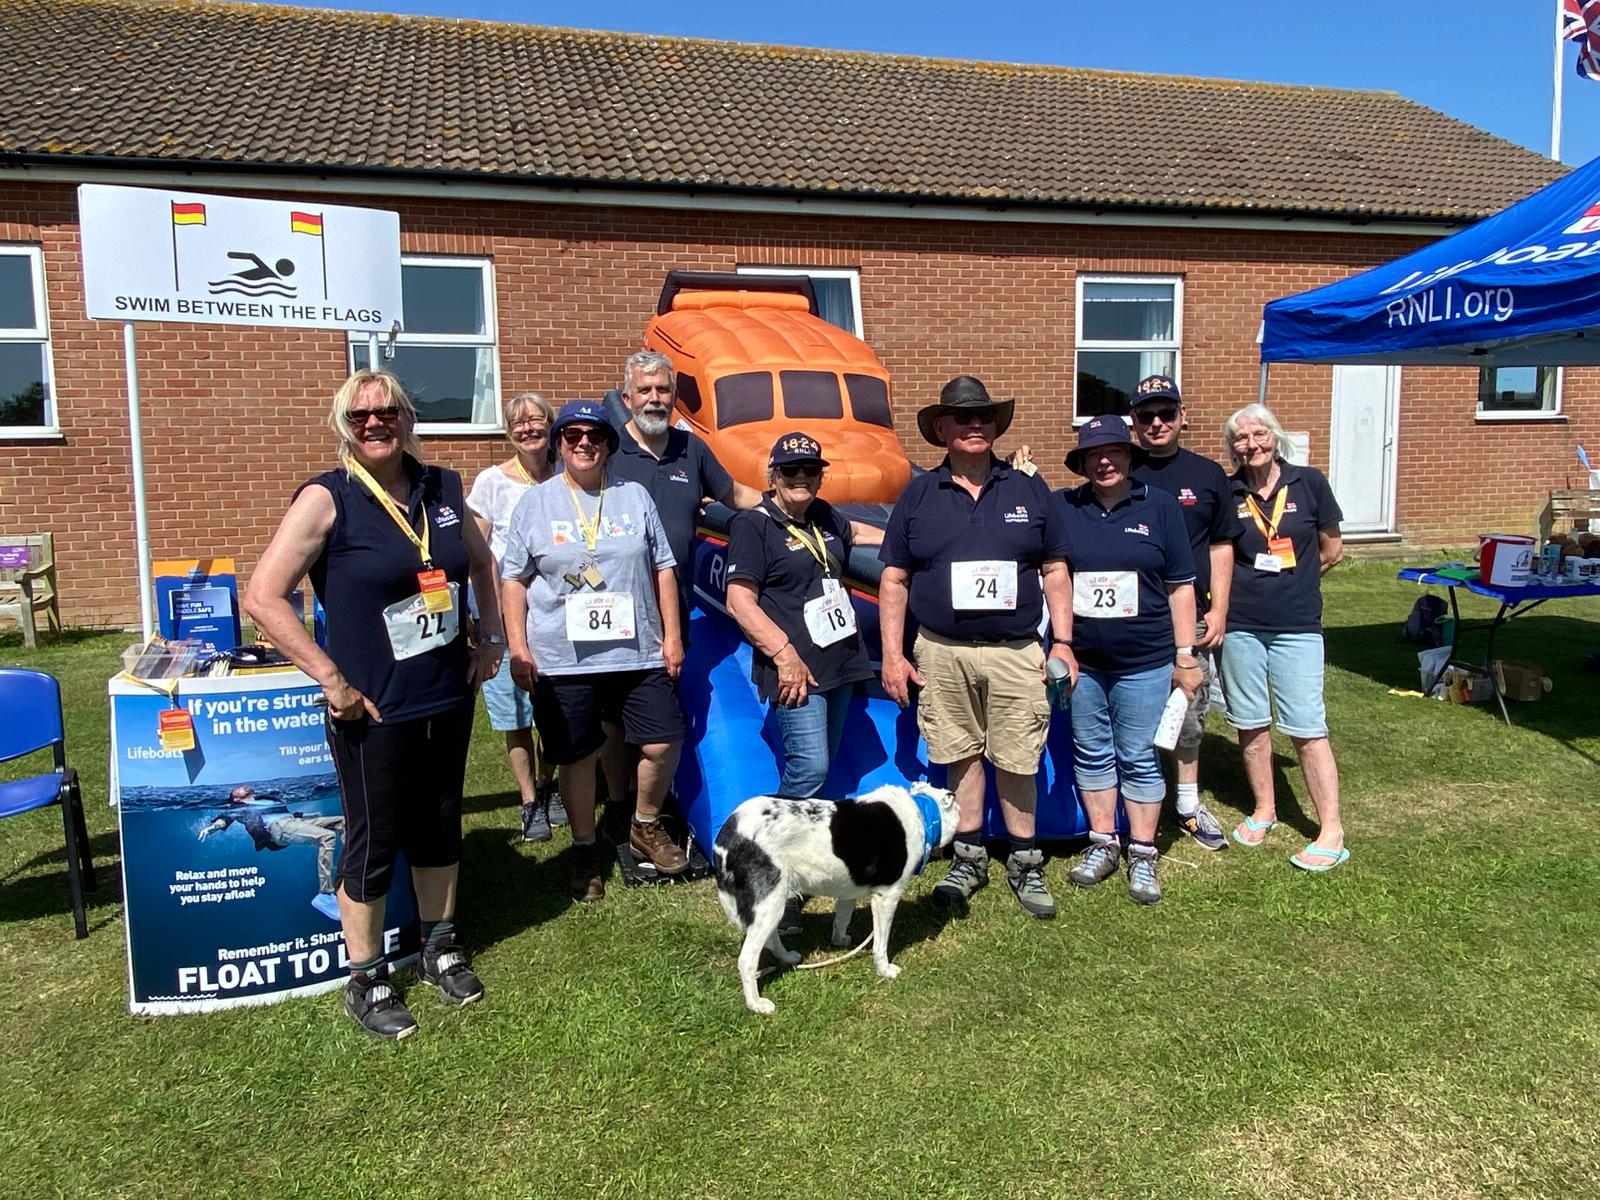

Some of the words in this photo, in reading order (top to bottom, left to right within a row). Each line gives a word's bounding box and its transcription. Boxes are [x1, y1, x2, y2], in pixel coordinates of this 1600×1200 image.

[115, 296, 170, 313] SWIM
[177, 299, 273, 319] BETWEEN
[280, 304, 317, 320] THE
[322, 307, 382, 324] FLAGS
[1386, 286, 1514, 328] RNLI.org
[975, 578, 998, 599] 24
[1093, 588, 1117, 608] 23
[416, 612, 447, 639] 22
[589, 609, 612, 630] 84
[827, 608, 846, 631] 18
[188, 699, 202, 716] If
[205, 696, 269, 718] you're
[213, 719, 232, 735] in
[235, 716, 269, 733] the
[271, 712, 325, 730] water
[279, 746, 297, 757] Tilt
[298, 744, 322, 756] your
[298, 756, 322, 765] ears
[175, 870, 206, 881] Relax
[206, 868, 227, 879] and
[228, 866, 258, 877] move
[169, 883, 194, 895] your
[195, 880, 228, 891] hands
[229, 879, 240, 888] to
[241, 876, 266, 886] help
[180, 895, 199, 906] you
[200, 892, 223, 903] stay
[224, 888, 256, 900] afloat
[218, 940, 293, 961] Remember
[295, 937, 308, 950] it.
[310, 930, 345, 947] Share
[178, 957, 281, 993] FLOAT
[288, 949, 330, 979] TO
